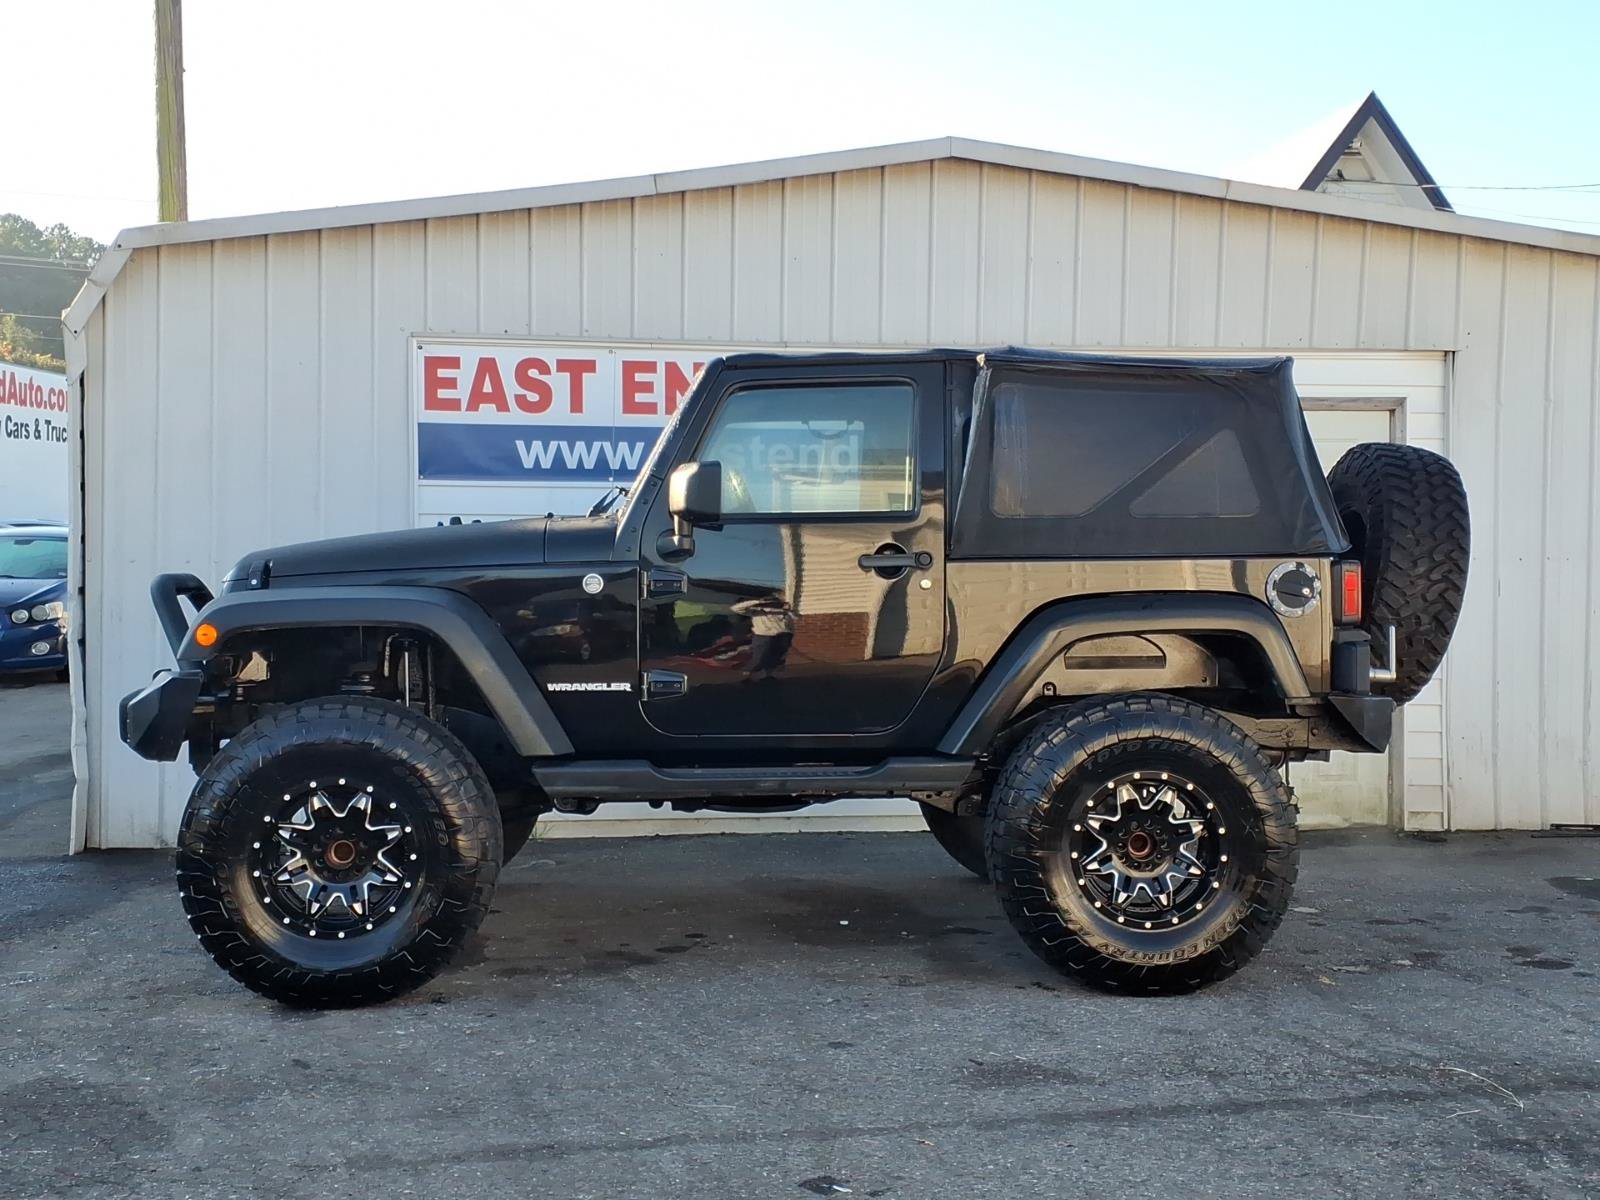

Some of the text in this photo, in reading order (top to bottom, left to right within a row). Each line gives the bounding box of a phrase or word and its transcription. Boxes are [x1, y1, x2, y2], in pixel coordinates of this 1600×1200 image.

[423, 355, 597, 415] EAST
[5, 415, 31, 440] Cars
[33, 417, 42, 441] &
[547, 682, 632, 692] WRANGLER
